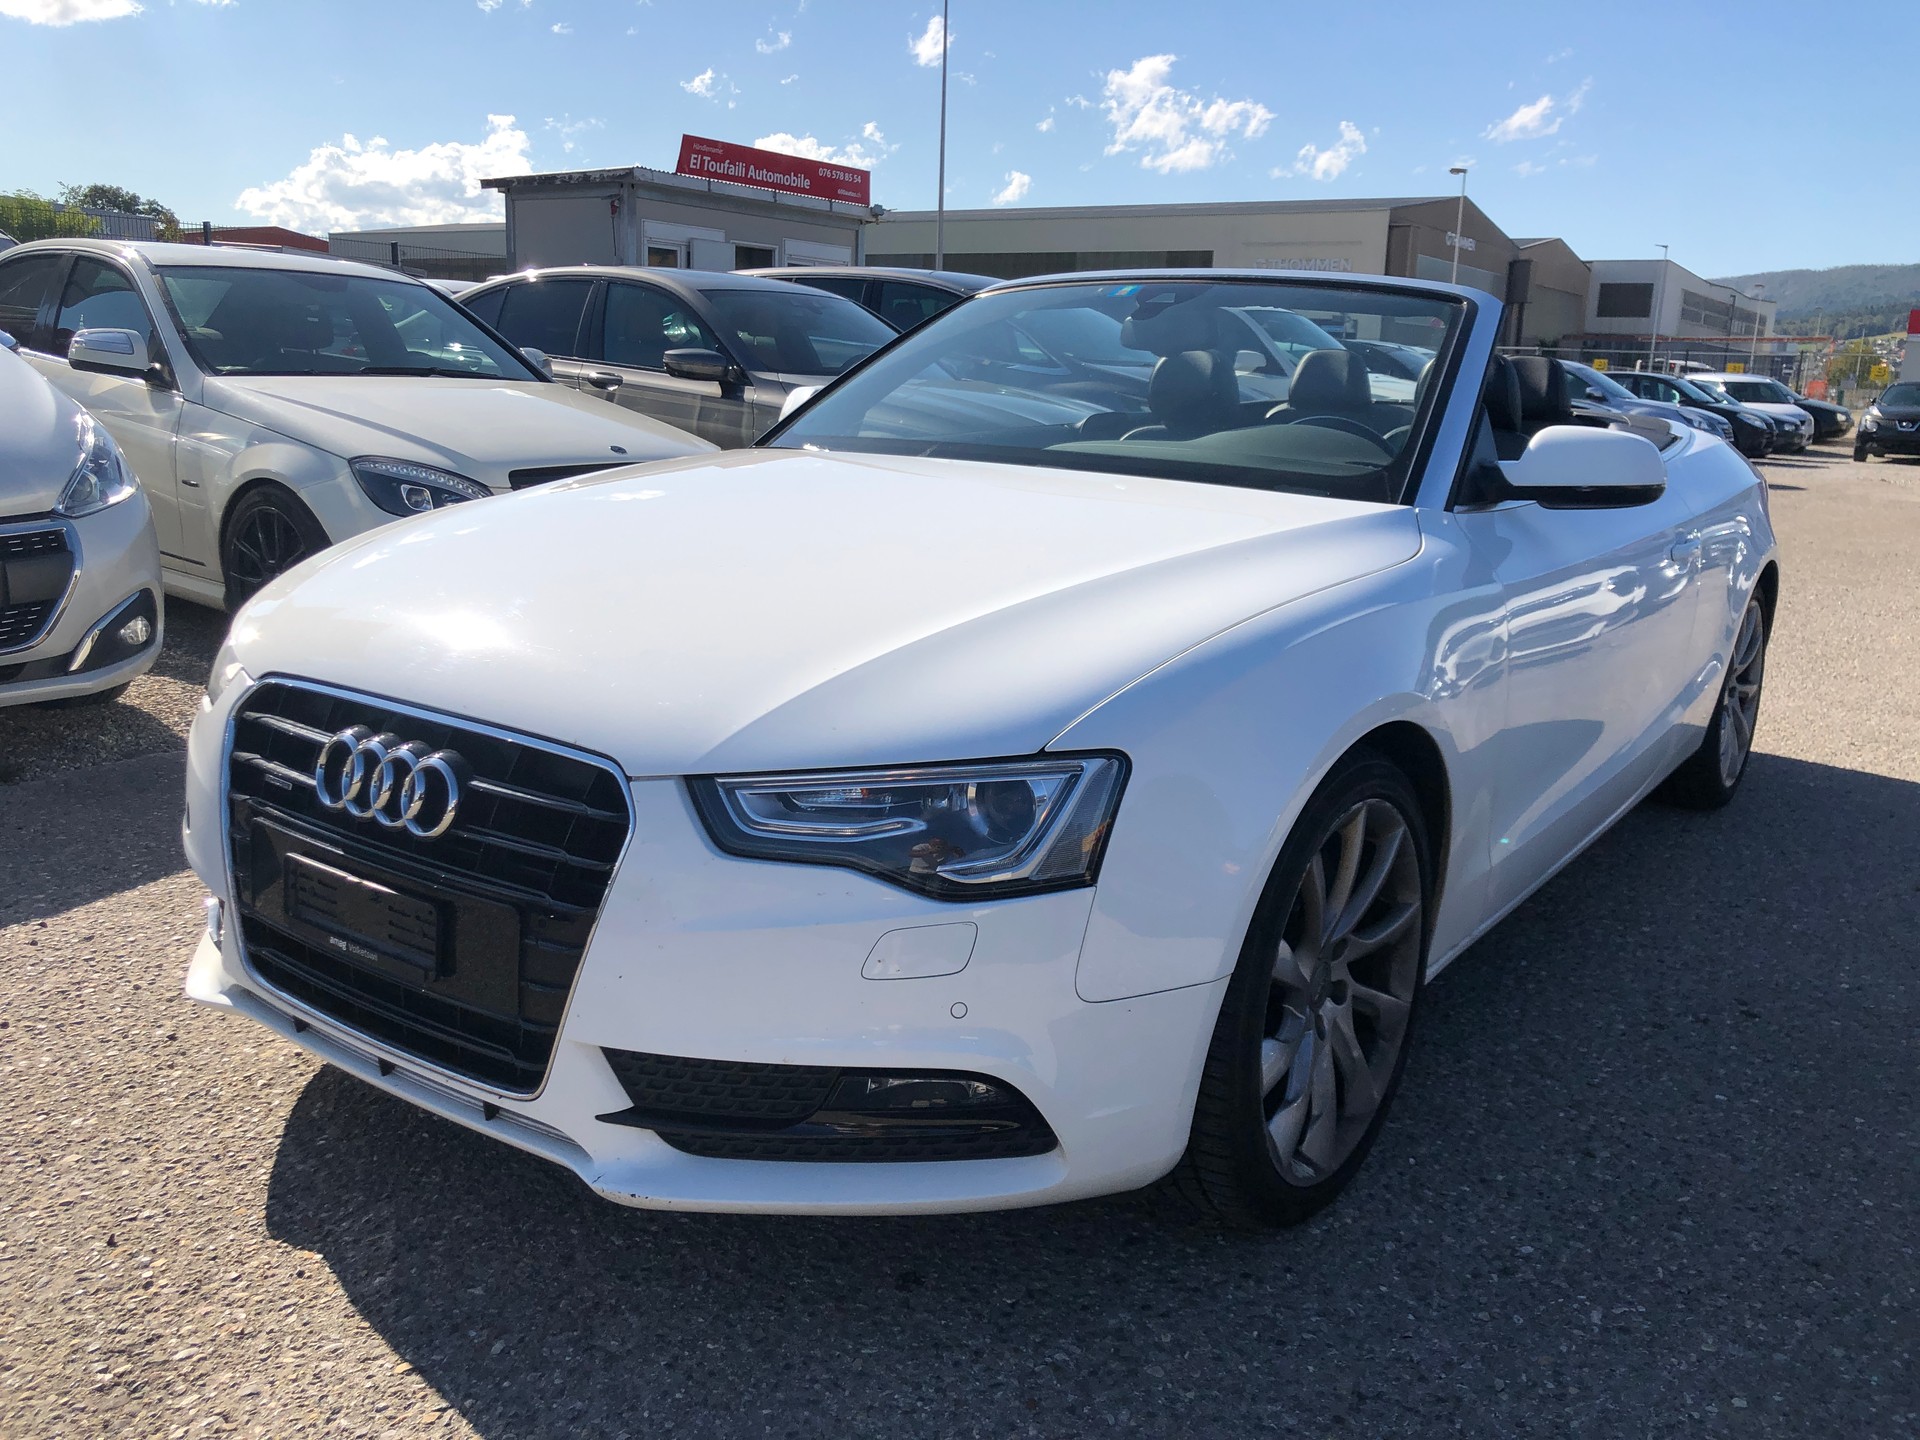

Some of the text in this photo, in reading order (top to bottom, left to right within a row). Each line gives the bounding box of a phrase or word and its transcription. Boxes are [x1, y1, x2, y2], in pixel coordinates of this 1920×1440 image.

[689, 154, 811, 190] El Toufaili Automobile
[818, 167, 862, 184] 076 578 85 54
[329, 936, 347, 951] amag
